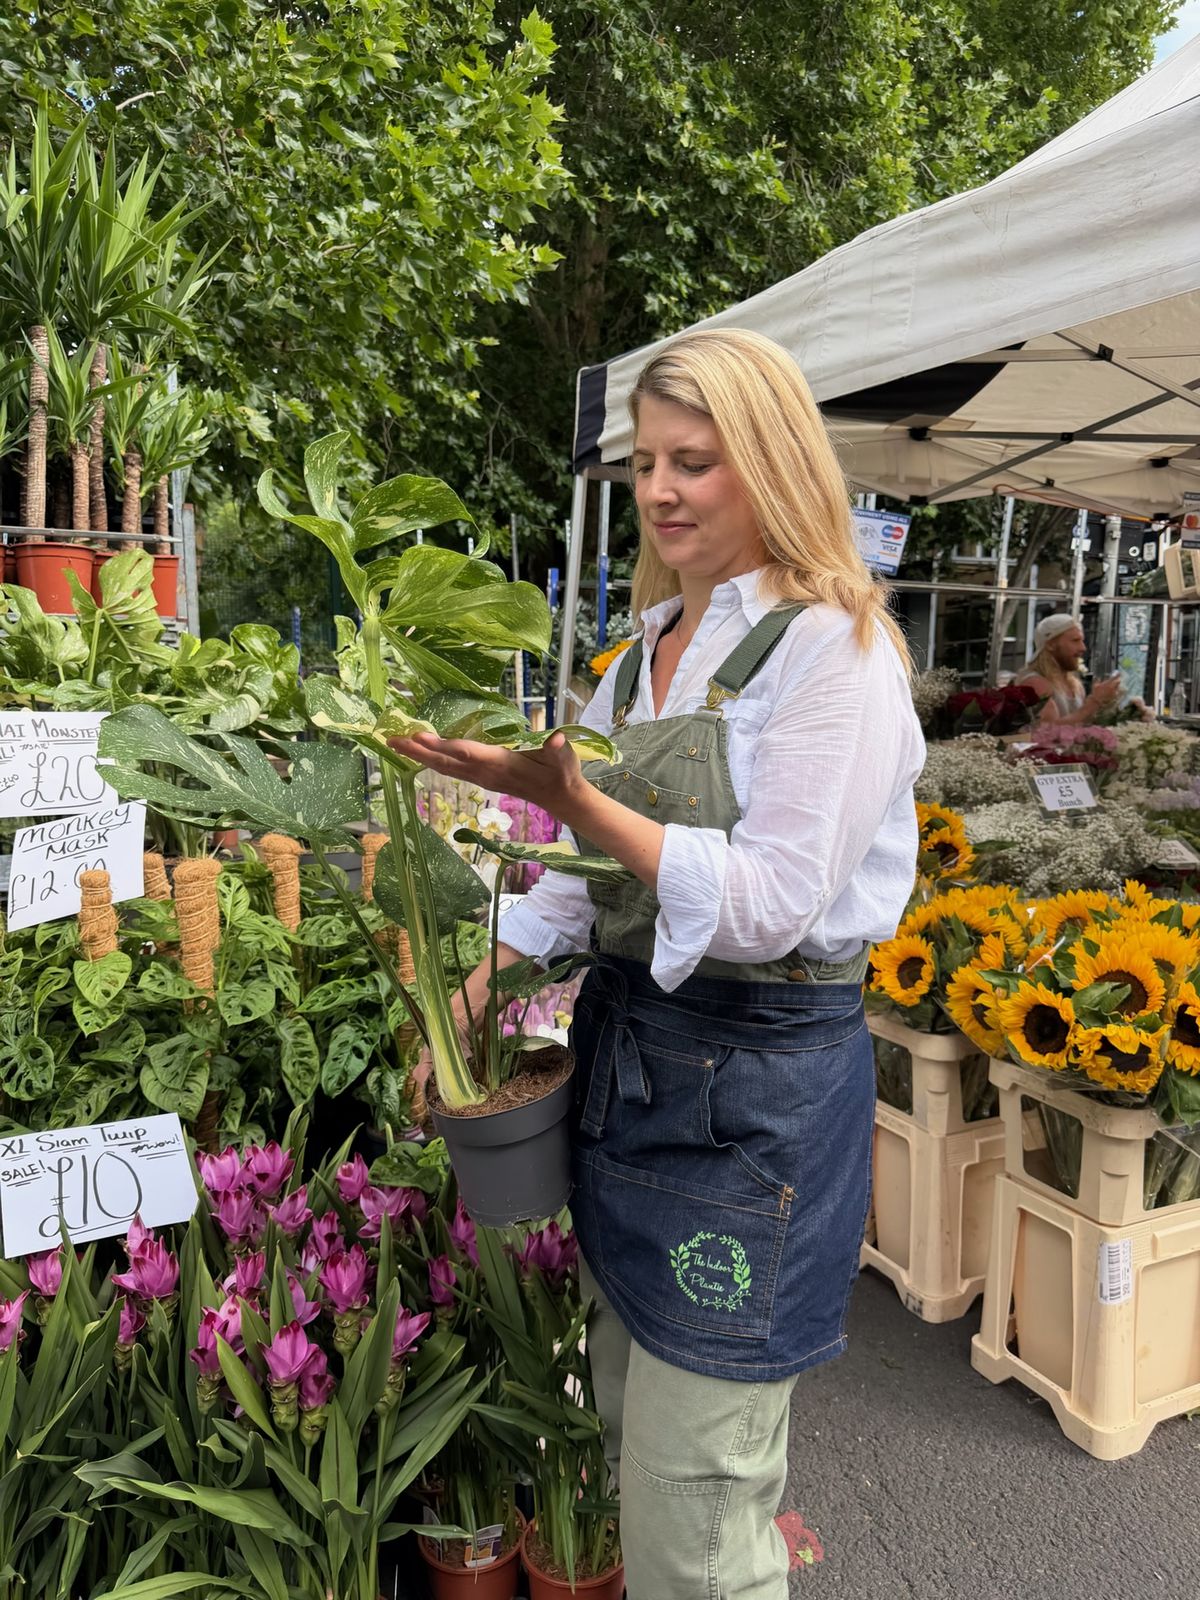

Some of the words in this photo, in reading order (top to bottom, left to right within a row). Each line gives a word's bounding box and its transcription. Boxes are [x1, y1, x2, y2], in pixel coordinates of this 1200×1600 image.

[20, 752, 106, 807] £20
[1037, 776, 1054, 786] GYP
[1056, 775, 1085, 784] EXTRA
[1058, 785, 1074, 797] £5
[1057, 797, 1083, 807] Bunch
[1, 1139, 30, 1157] XL
[1, 1160, 47, 1182] SALE!
[39, 1151, 142, 1237] £10
[691, 1252, 706, 1267] The
[706, 1254, 733, 1273] Indoor
